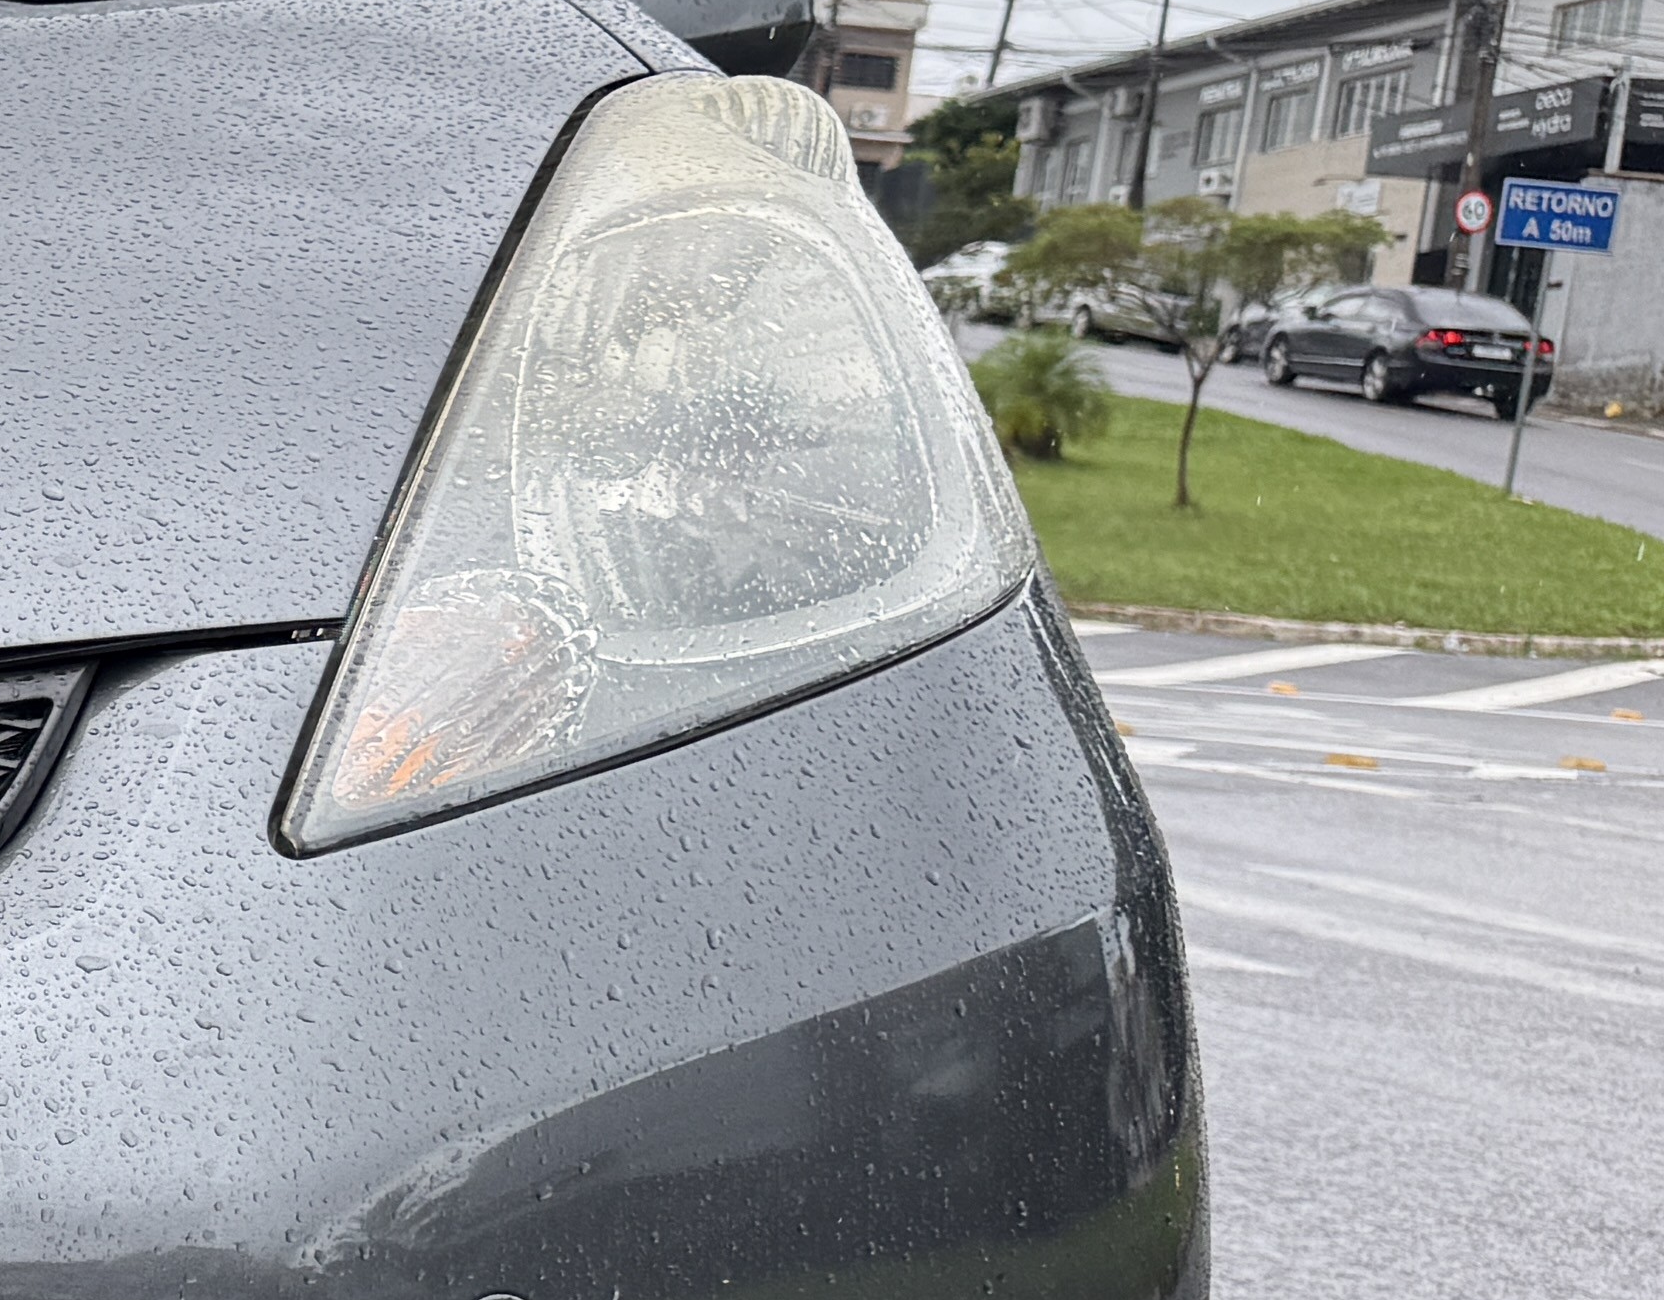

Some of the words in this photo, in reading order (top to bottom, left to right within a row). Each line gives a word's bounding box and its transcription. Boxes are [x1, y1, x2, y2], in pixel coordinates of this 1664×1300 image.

[1509, 186, 1613, 218] RETORNO
[1522, 216, 1540, 240] A
[1549, 218, 1592, 244] 50m
